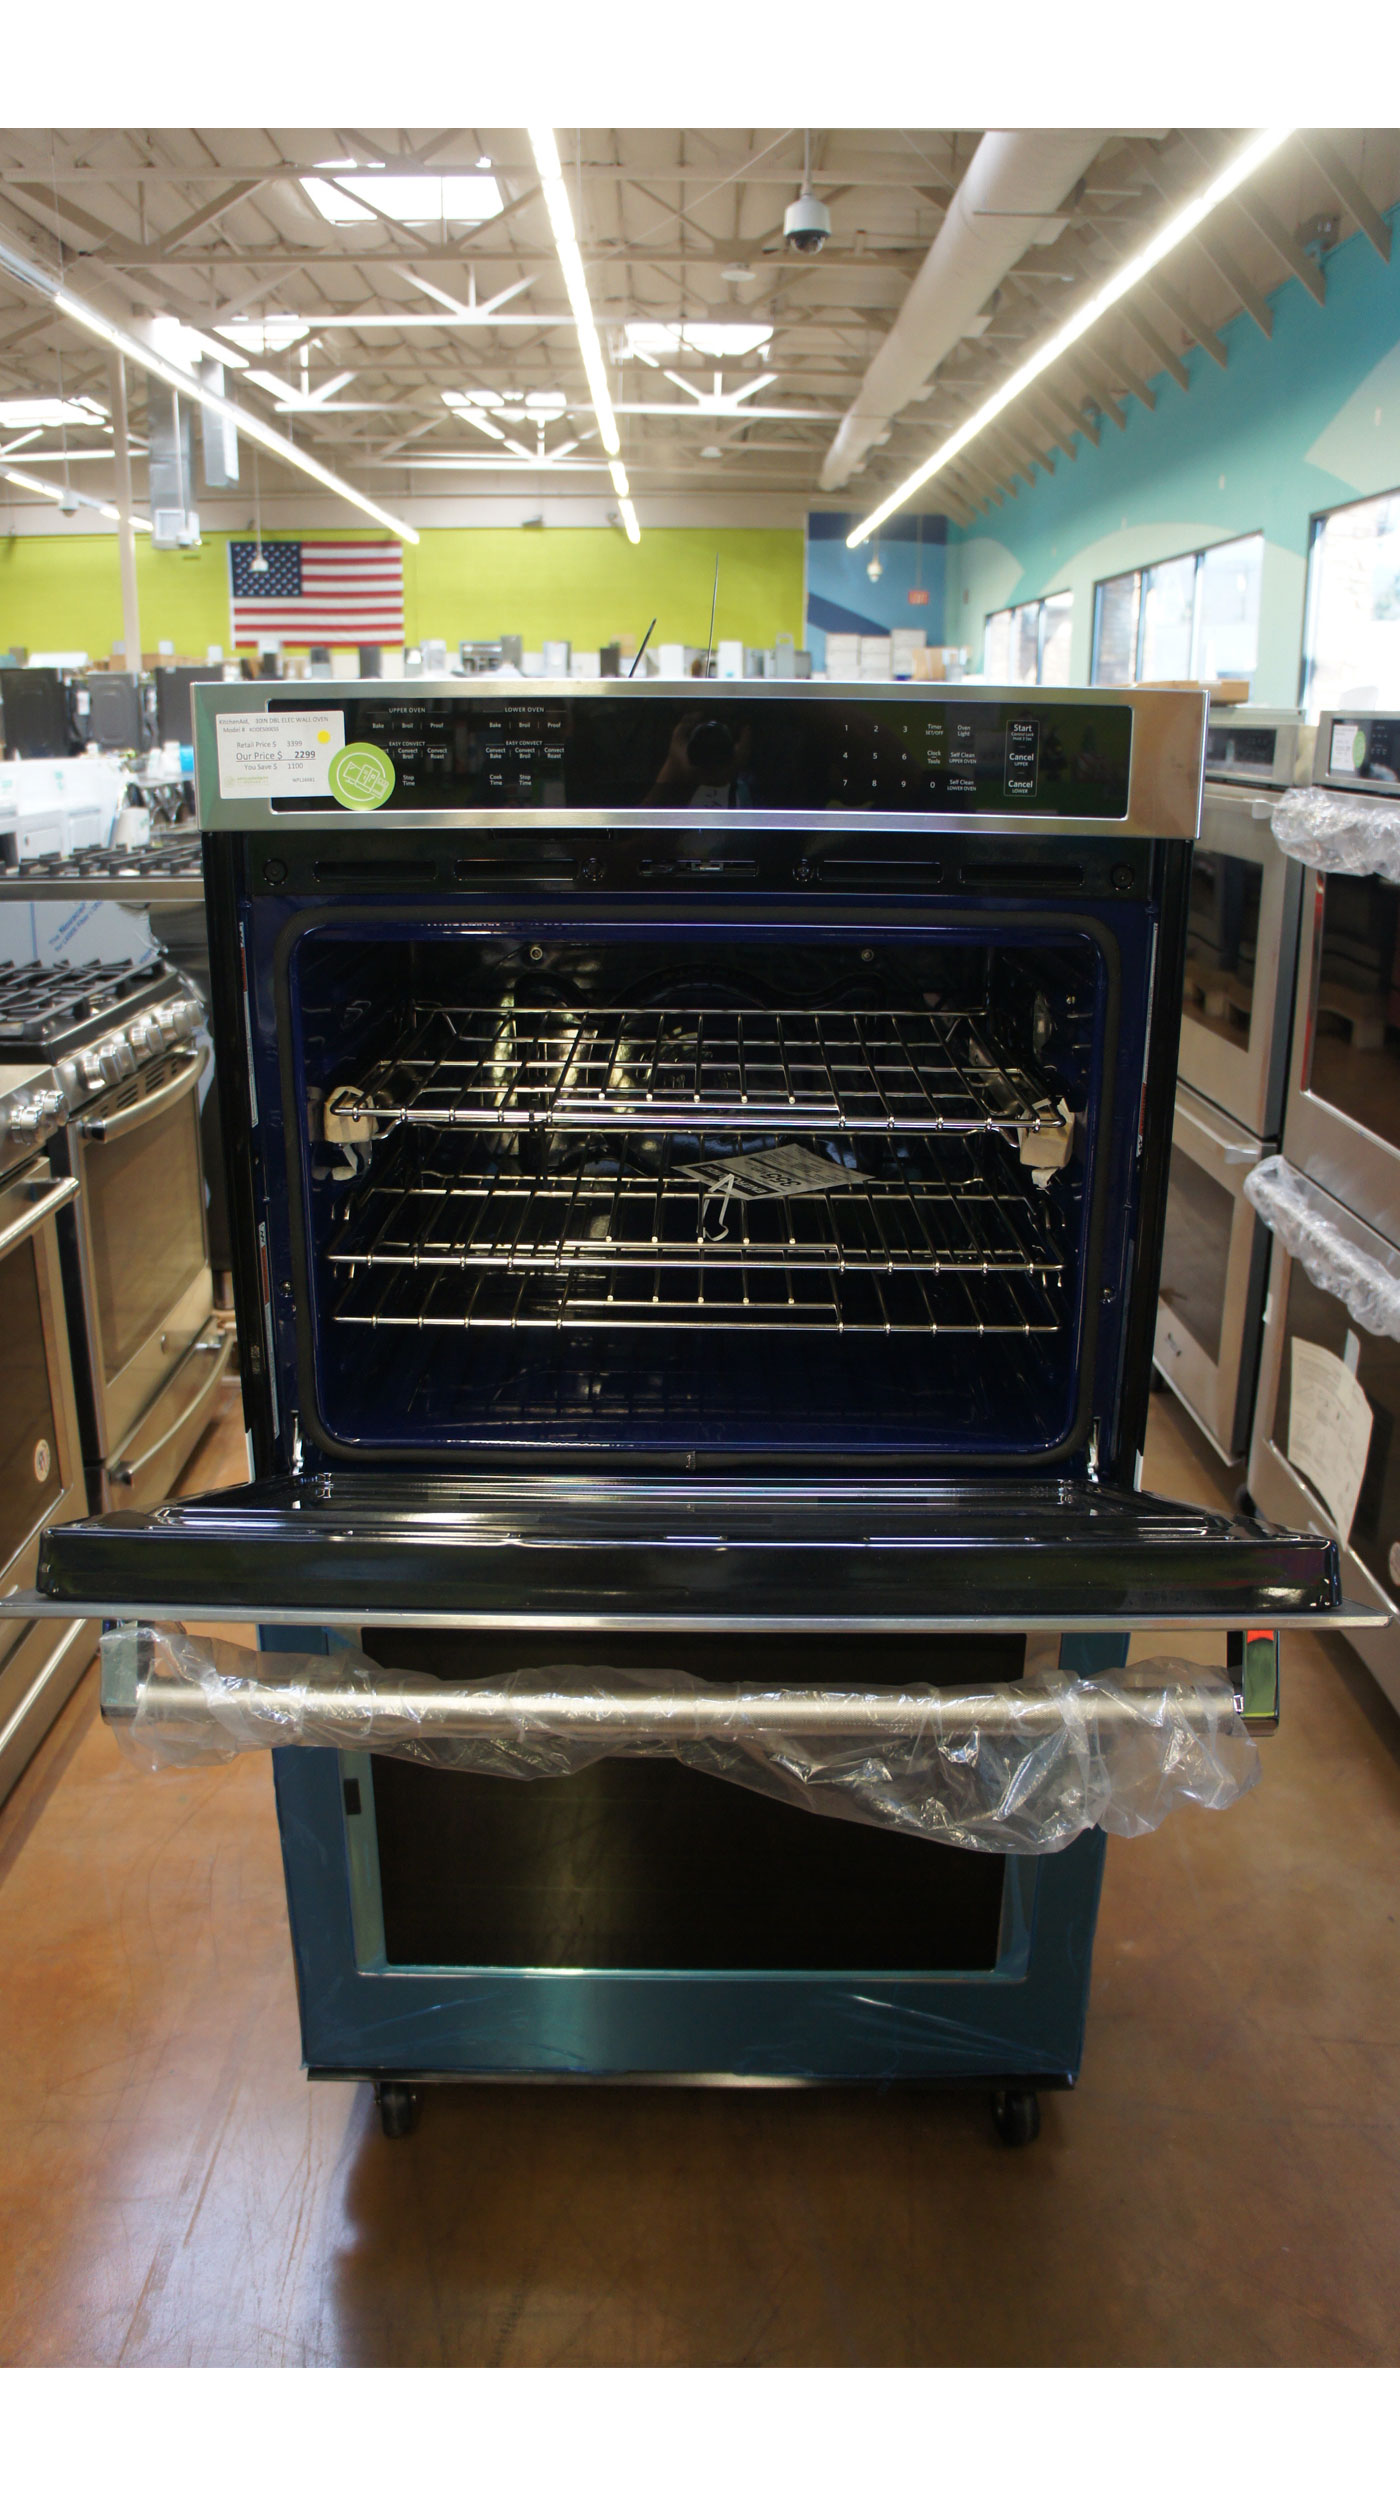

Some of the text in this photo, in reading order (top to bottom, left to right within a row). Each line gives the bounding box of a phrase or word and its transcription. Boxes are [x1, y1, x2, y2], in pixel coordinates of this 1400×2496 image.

[844, 724, 849, 732] 1
[903, 725, 908, 733] 3
[1013, 723, 1032, 732] Start
[236, 752, 252, 760] Our
[254, 752, 275, 760] Price
[277, 750, 282, 760] $
[873, 752, 878, 760] 5
[1009, 753, 1034, 761] Cancel
[843, 779, 848, 787] 7
[901, 780, 906, 788] 9
[930, 781, 935, 789] 0
[1008, 780, 1033, 788] Cancel
[760, 1172, 801, 1187] 355
